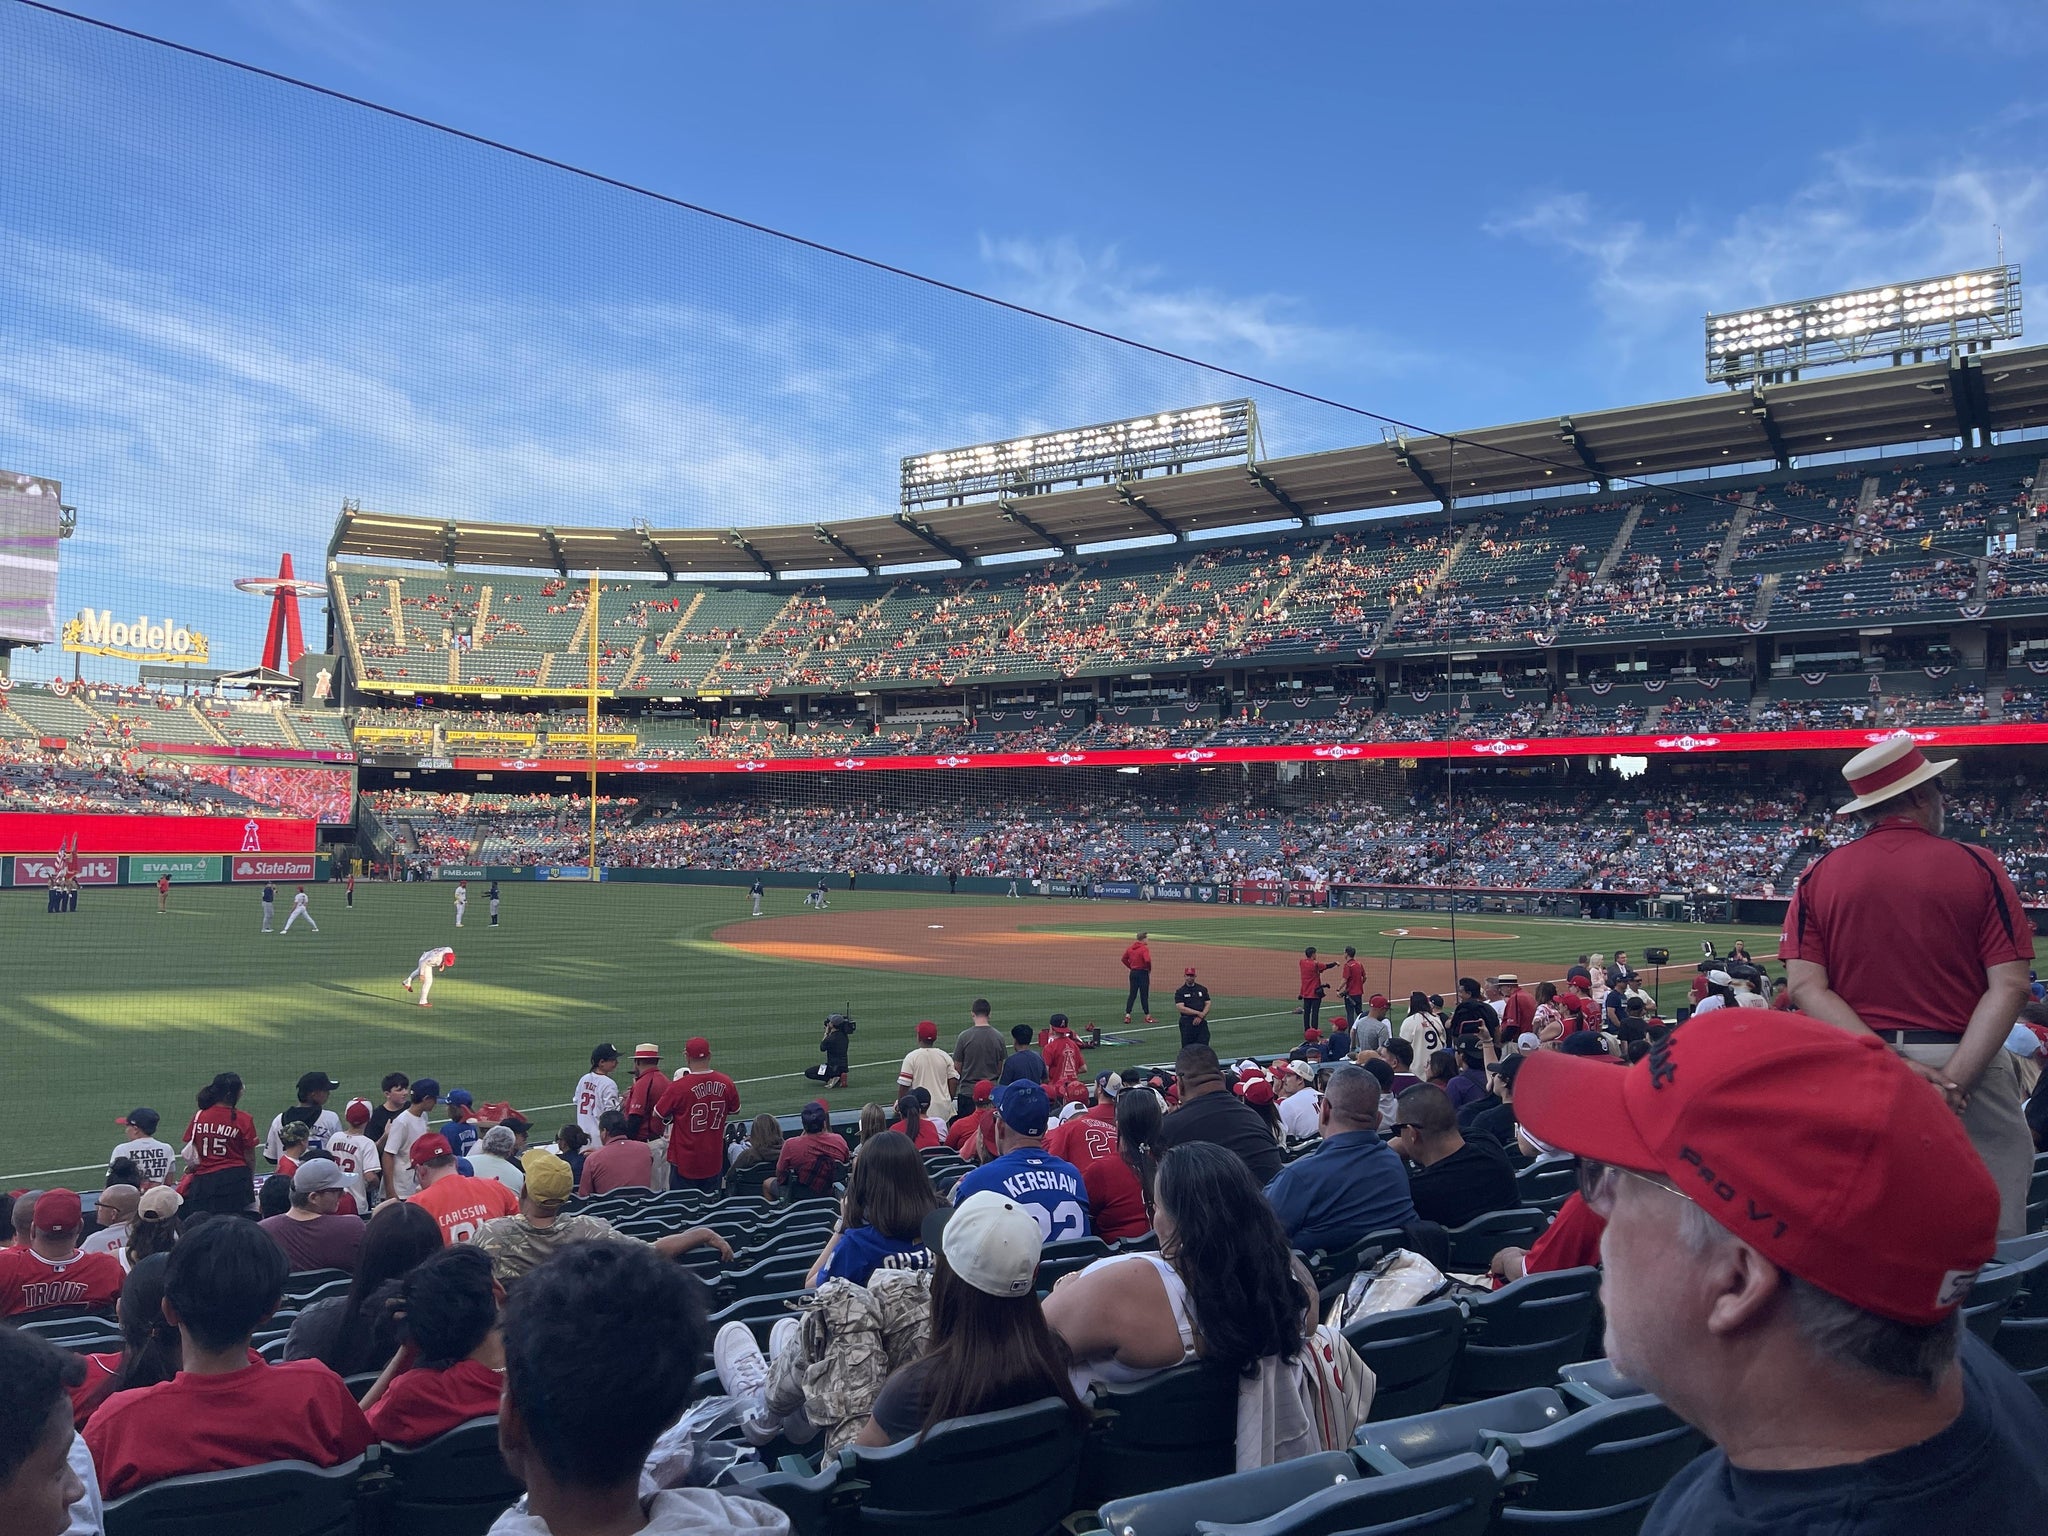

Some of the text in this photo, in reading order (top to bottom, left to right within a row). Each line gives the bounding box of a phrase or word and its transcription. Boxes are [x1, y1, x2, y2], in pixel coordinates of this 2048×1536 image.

[82, 608, 191, 651] Modelo
[1158, 888, 1181, 898] Modelo
[1425, 1031, 1438, 1050] 9
[691, 1081, 726, 1100] TROUT
[691, 1101, 726, 1133] 27
[197, 1123, 239, 1138] SALMON
[130, 1149, 163, 1159] KING
[203, 1137, 227, 1157] 15
[1003, 1171, 1077, 1198] KERSHAW
[1680, 1145, 1788, 1239] PRO V1
[439, 1204, 487, 1227] CARLSSON
[22, 1281, 89, 1308] TROUT
